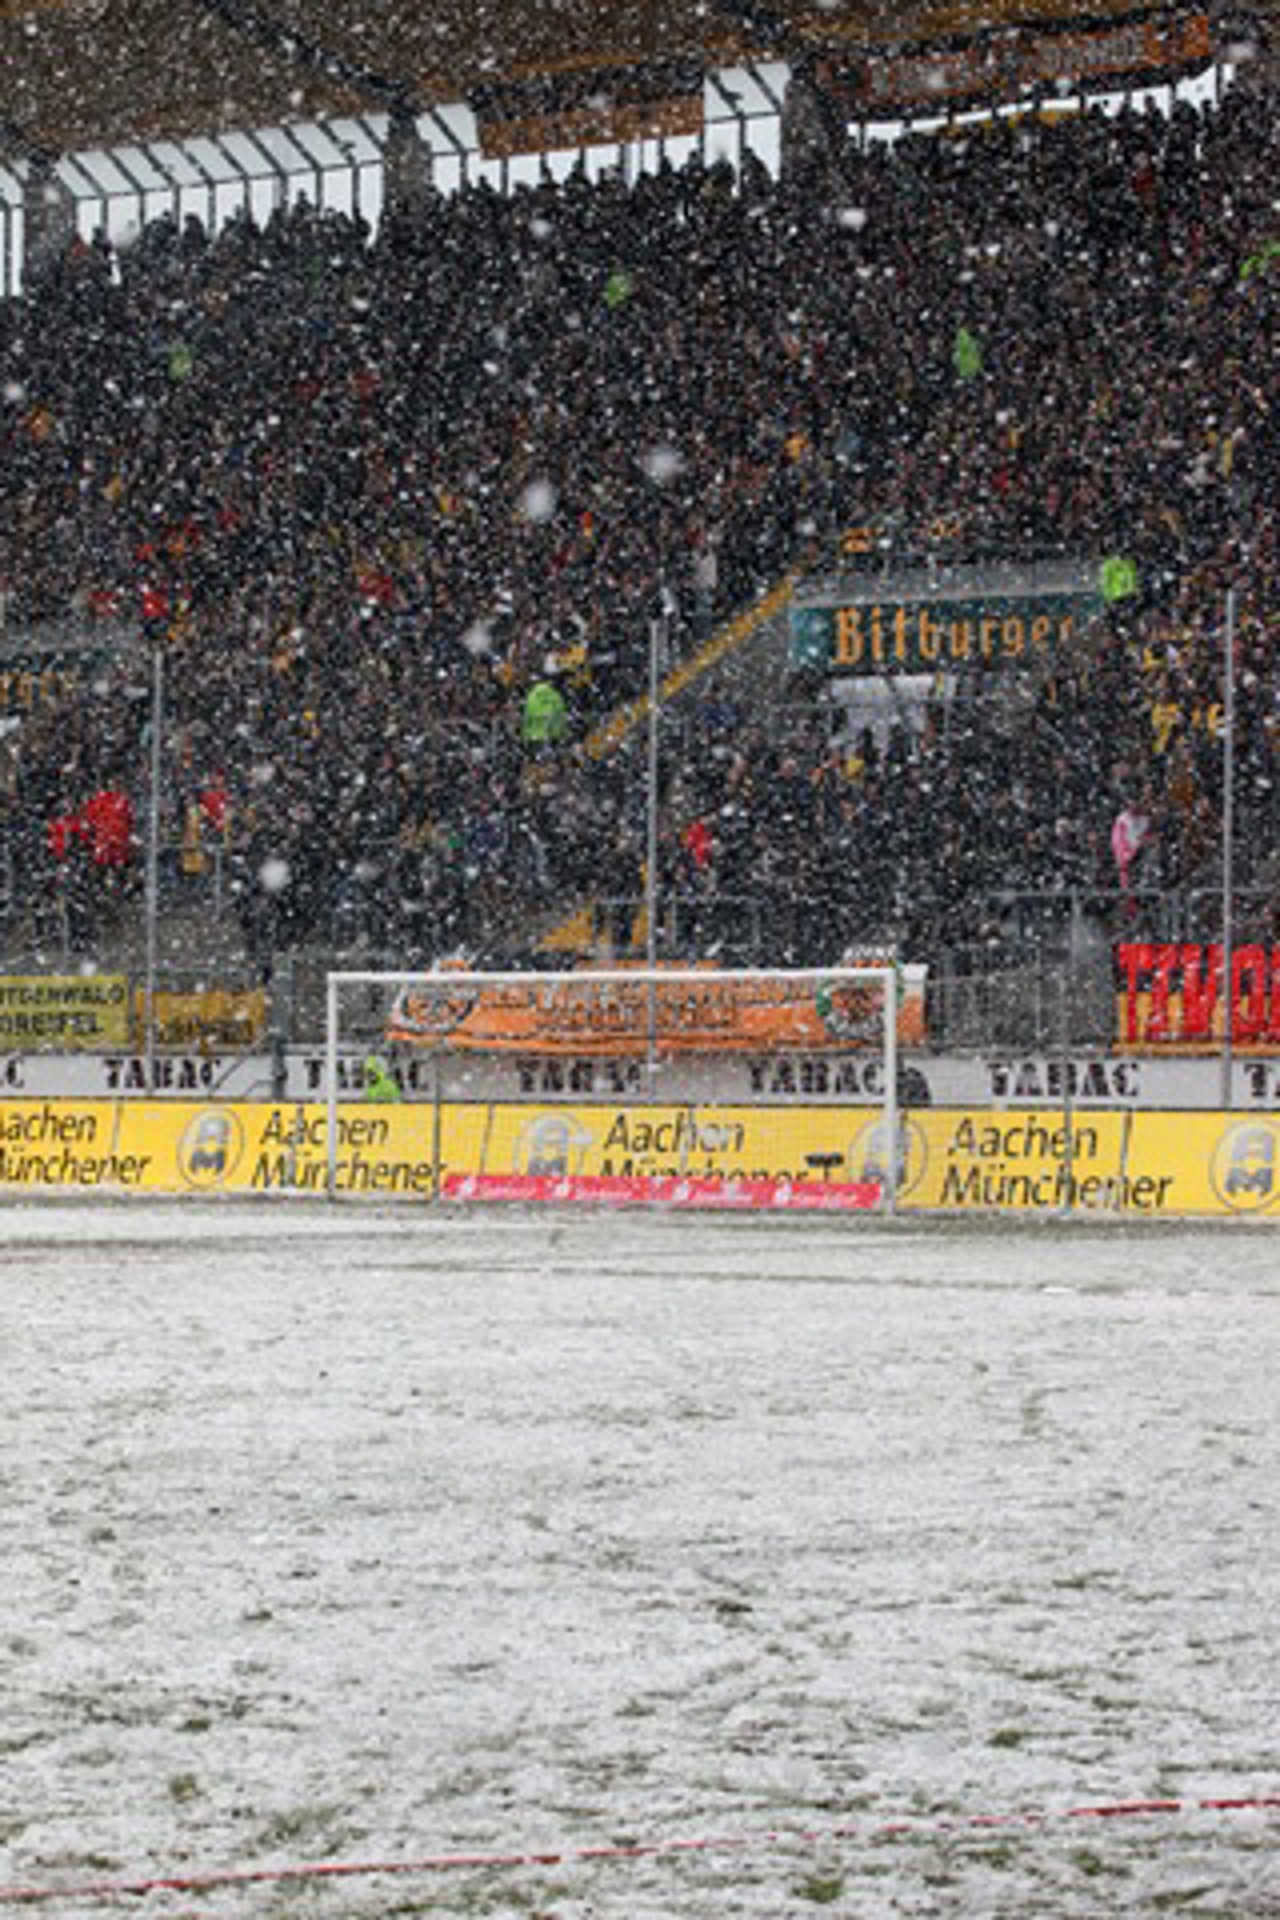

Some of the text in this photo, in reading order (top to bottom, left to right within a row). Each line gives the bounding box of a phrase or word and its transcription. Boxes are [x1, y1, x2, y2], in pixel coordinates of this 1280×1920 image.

[830, 606, 1075, 665] Bitburger
[1119, 943, 1280, 1046] TIVO
[104, 1058, 221, 1089] TABAC
[748, 1058, 885, 1093] TABAC
[987, 1062, 1138, 1096] TABAC
[0, 1104, 98, 1142] achen
[259, 1111, 390, 1146] Aachen
[948, 1116, 1098, 1158] Aachen
[0, 1147, 152, 1184] ünchener
[939, 1163, 1173, 1208] Münchener
